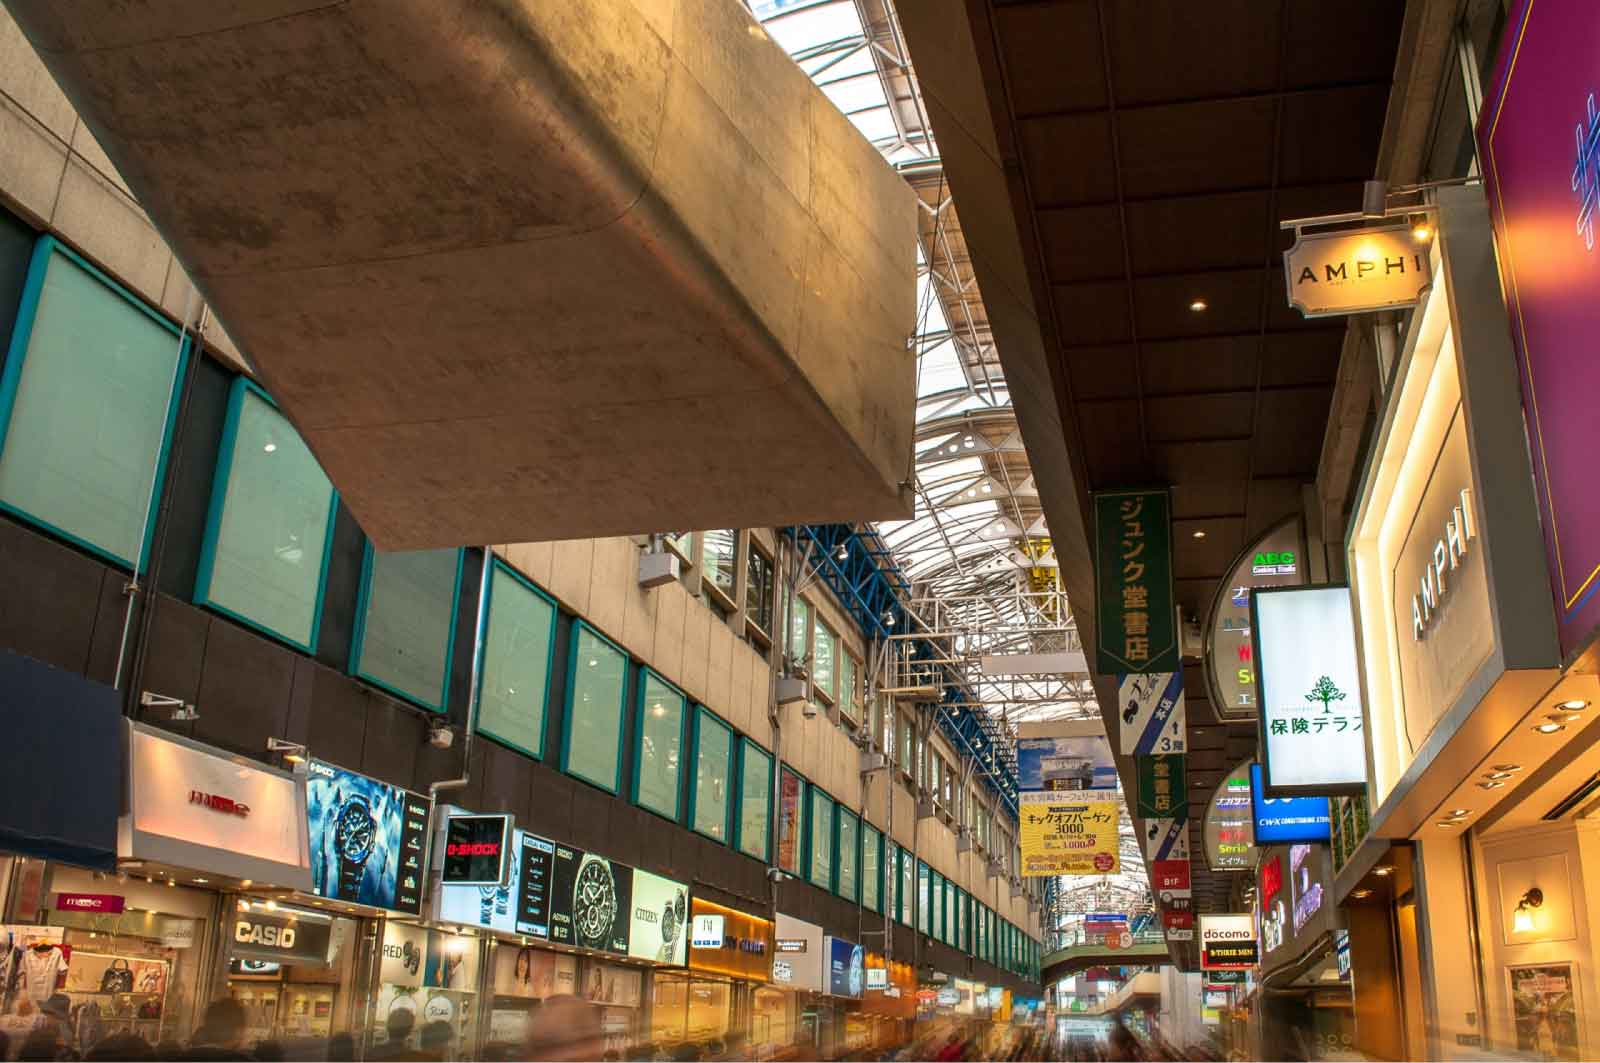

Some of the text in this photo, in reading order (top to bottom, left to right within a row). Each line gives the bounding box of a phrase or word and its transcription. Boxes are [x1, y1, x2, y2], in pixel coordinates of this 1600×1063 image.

[1298, 255, 1421, 285] AMPHI
[1252, 552, 1295, 565] ABC
[1411, 488, 1477, 642] AMPHI
[1120, 497, 1149, 661] ジュンク堂書店
[1055, 824, 1084, 834] 3000
[235, 921, 296, 948] CASIO
[1203, 929, 1250, 939] docomo
